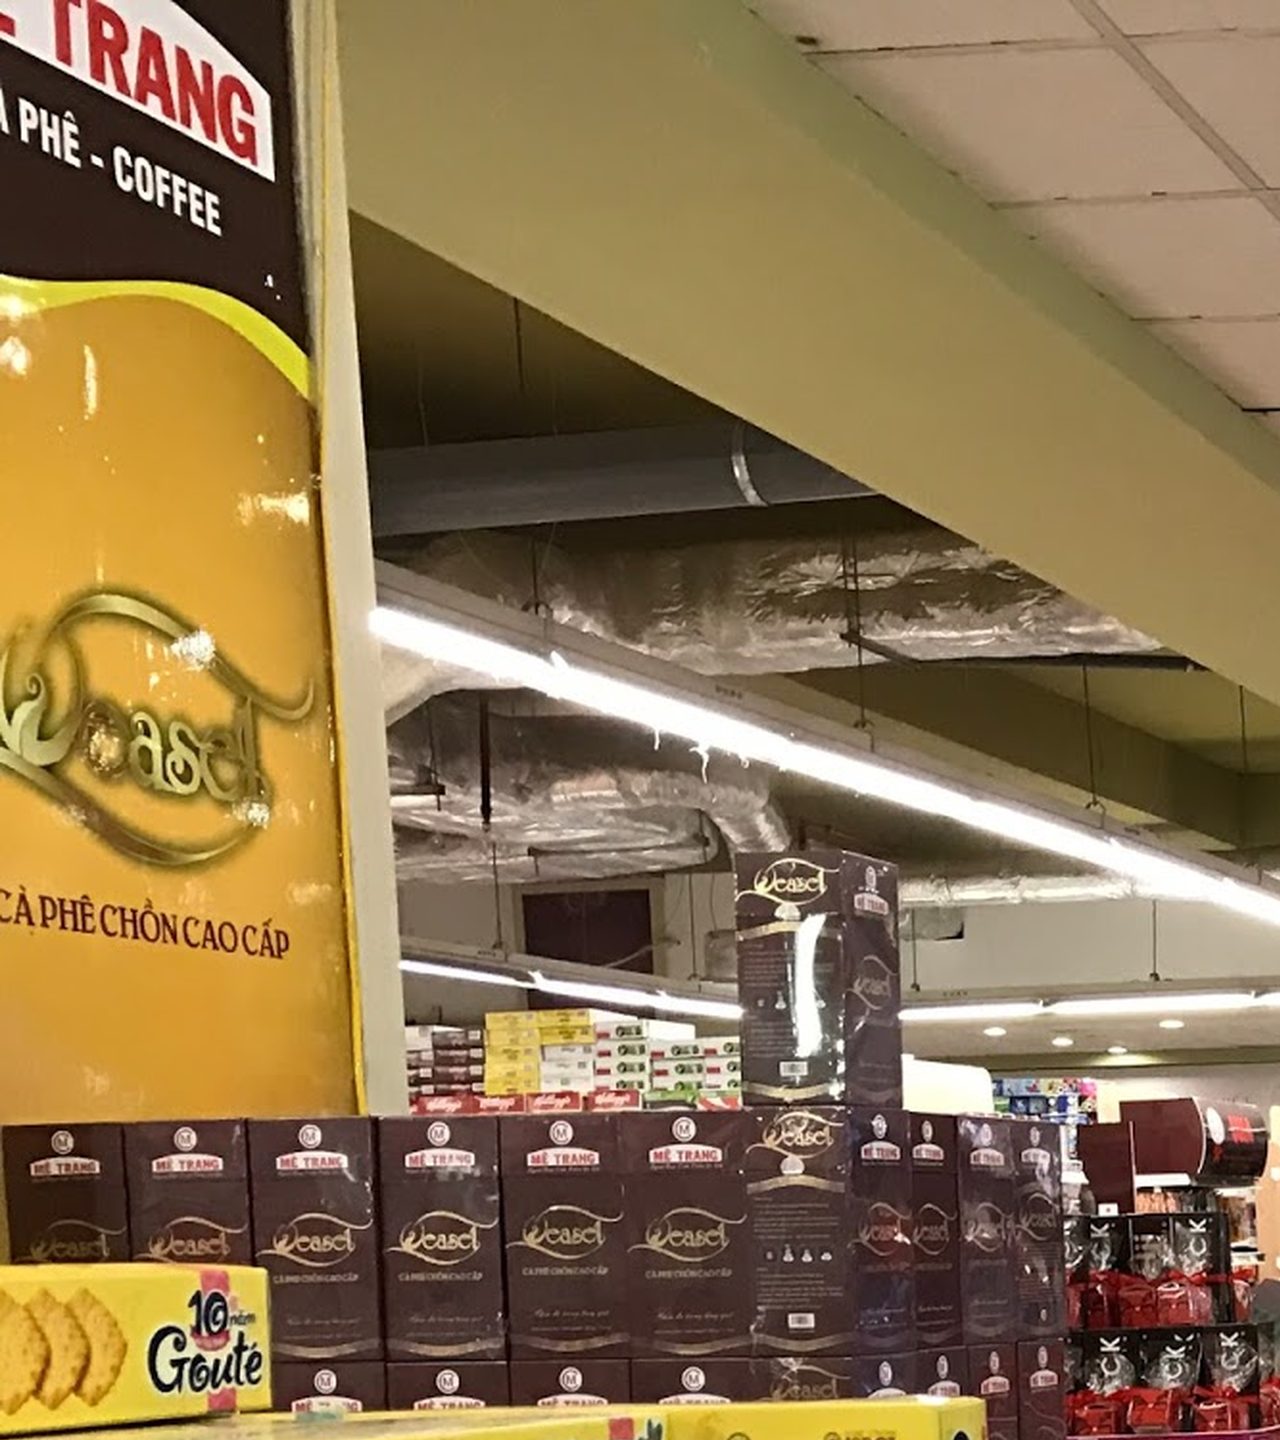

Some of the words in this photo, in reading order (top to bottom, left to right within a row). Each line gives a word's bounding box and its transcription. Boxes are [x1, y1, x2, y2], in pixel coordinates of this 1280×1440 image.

[52, 0, 258, 165] TRANG
[18, 98, 82, 168] PHÊ
[113, 145, 222, 237] COFFEE
[39, 895, 97, 934] PHÊ
[100, 897, 179, 945] CHỒN
[183, 918, 238, 955] CAO
[242, 916, 290, 960] CẤP
[187, 1289, 230, 1336] 10
